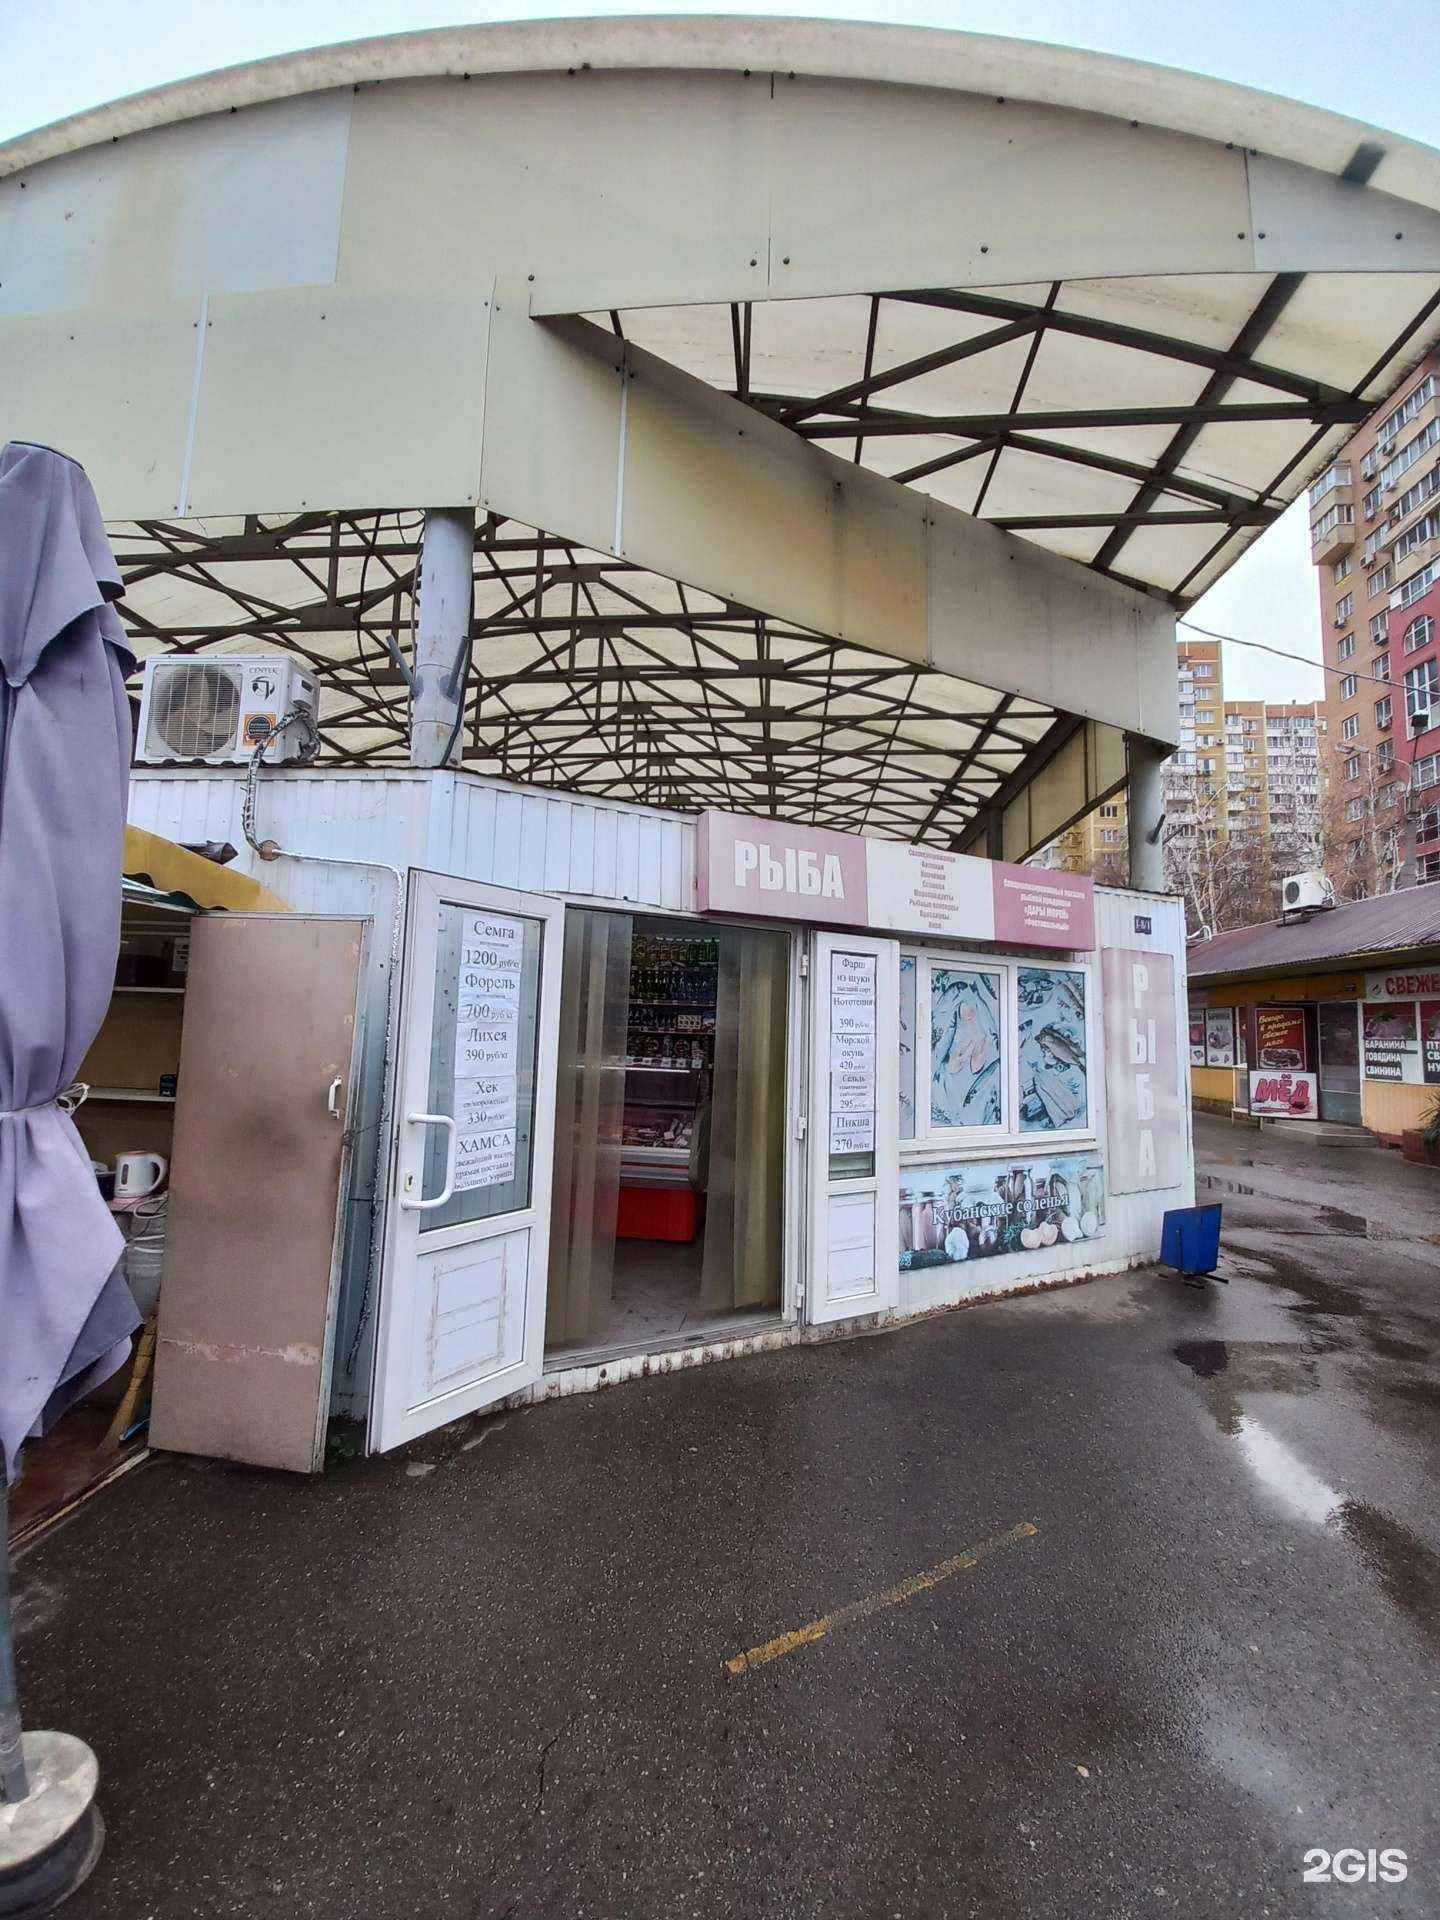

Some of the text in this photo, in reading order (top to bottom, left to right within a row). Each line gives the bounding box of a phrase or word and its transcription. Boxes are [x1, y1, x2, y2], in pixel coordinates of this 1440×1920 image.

[734, 839, 845, 899] РЫБА
[473, 921, 515, 939] Семга
[465, 949, 497, 965] 1200
[465, 972, 516, 992] Форель
[466, 1003, 490, 1018] 700
[465, 1049, 485, 1061] 390
[1366, 1051, 1401, 1062] ГОВЯДИНА
[1129, 963, 1156, 1177] РЫБА
[1366, 1065, 1401, 1077] СВИНИНА
[475, 1081, 499, 1095] Хек
[1254, 1074, 1310, 1105] МЁД
[467, 1111, 487, 1125] 330
[459, 1133, 511, 1154] ХАМСА
[835, 1138, 853, 1150] 270
[932, 1194, 1070, 1225] Кубанские соленья
